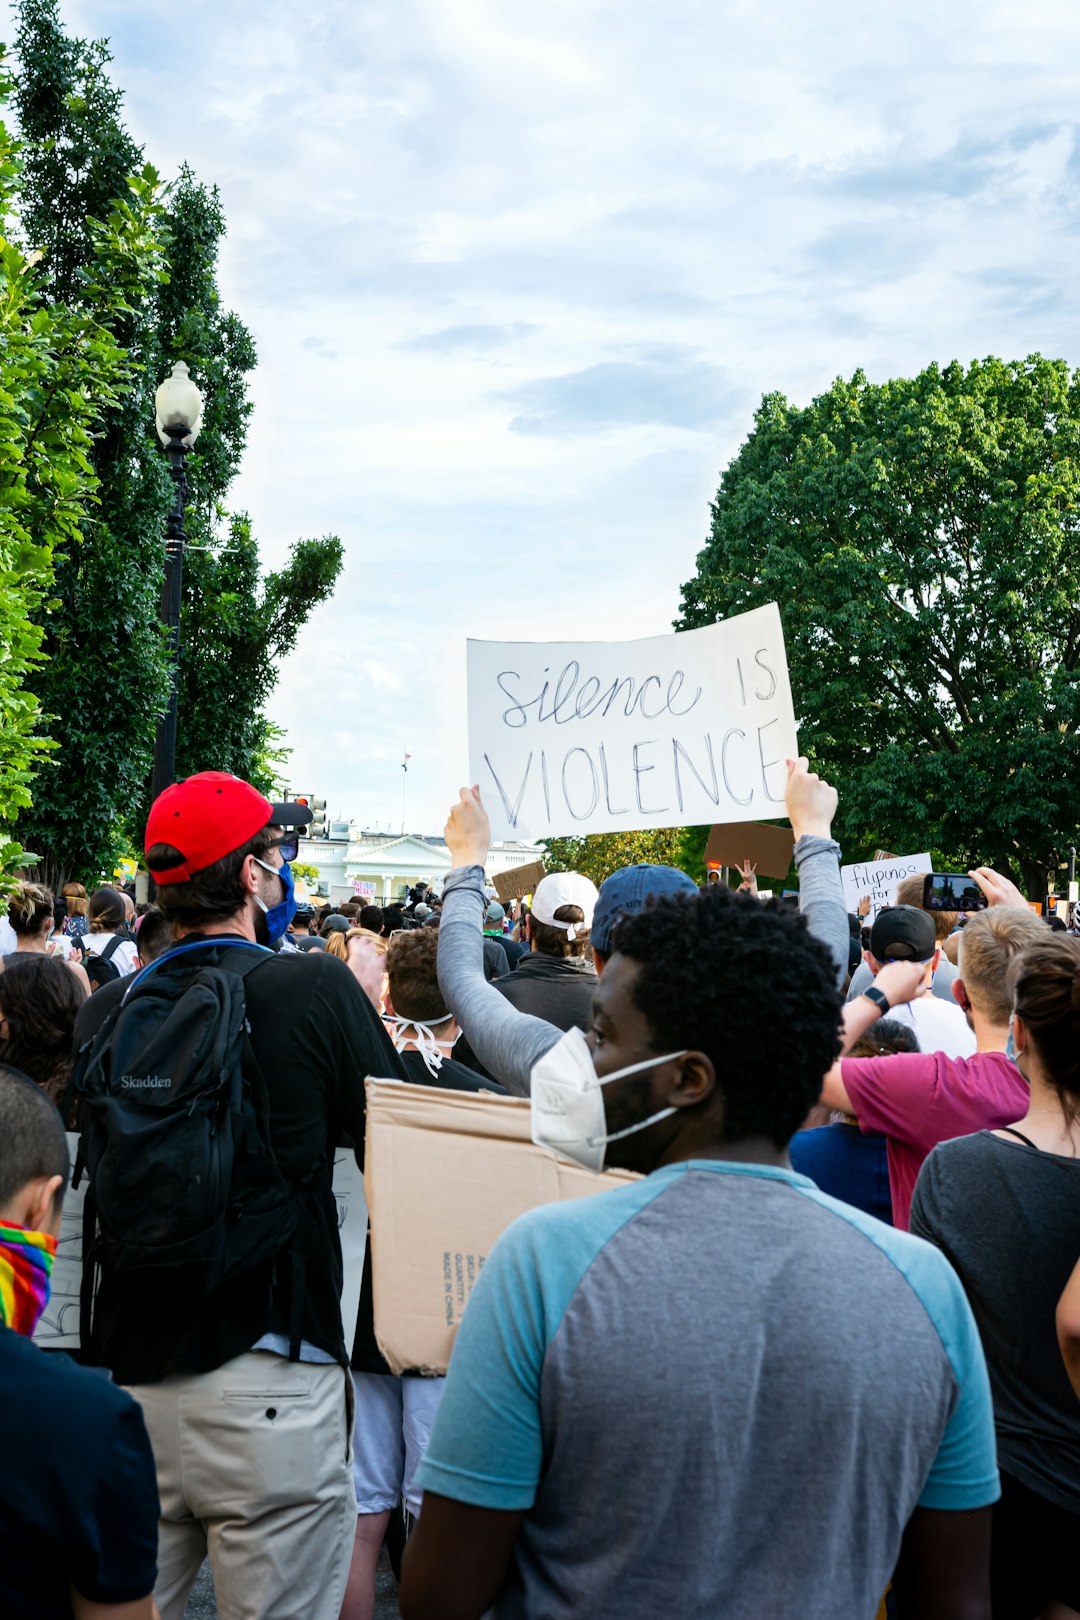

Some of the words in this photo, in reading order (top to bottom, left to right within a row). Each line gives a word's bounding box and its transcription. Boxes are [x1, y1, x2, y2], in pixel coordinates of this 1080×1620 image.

[736, 648, 778, 705] IS
[483, 718, 785, 829] VIOLENCE
[870, 886, 892, 899] for
[121, 1074, 172, 1088] Skadden
[444, 1252, 452, 1280] MADE
[445, 1282, 452, 1293] IN
[445, 1296, 454, 1326] CHINA
